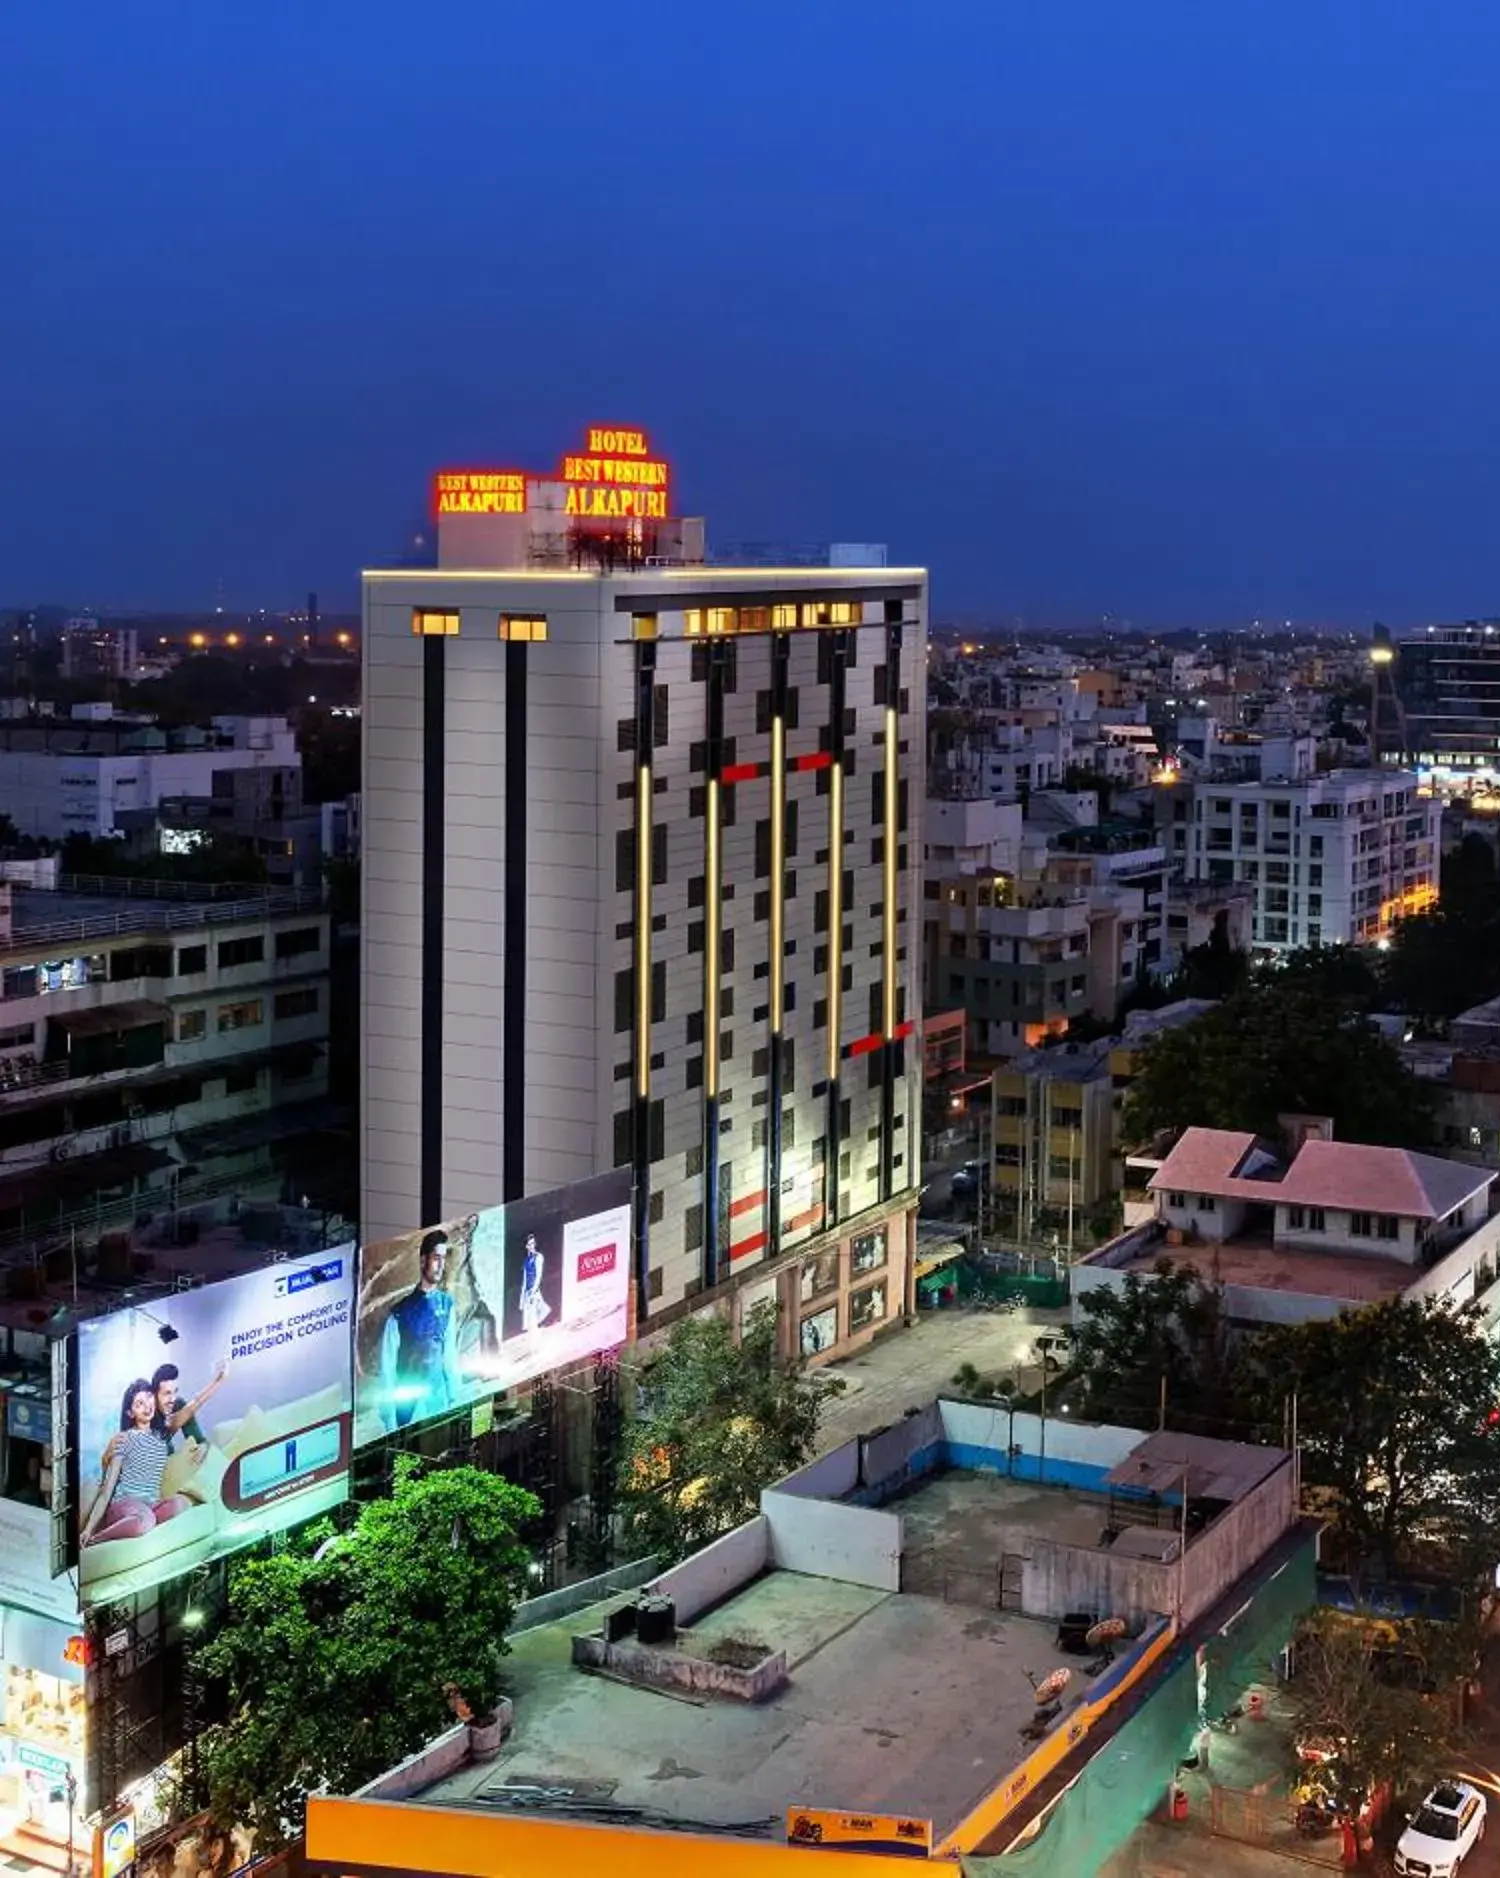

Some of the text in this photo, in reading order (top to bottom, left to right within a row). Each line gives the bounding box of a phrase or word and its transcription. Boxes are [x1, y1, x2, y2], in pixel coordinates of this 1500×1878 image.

[589, 430, 647, 455] HOTEL
[438, 475, 467, 490] BEST
[564, 457, 667, 485] BEST WESTERN
[438, 492, 524, 512] ALKAPURI
[564, 487, 667, 517] ALKAPURI
[231, 1327, 263, 1345] ENJOY
[265, 1320, 284, 1335] THE
[287, 1303, 333, 1327] COMFORT
[231, 1312, 348, 1360] PRECISION COOLING
